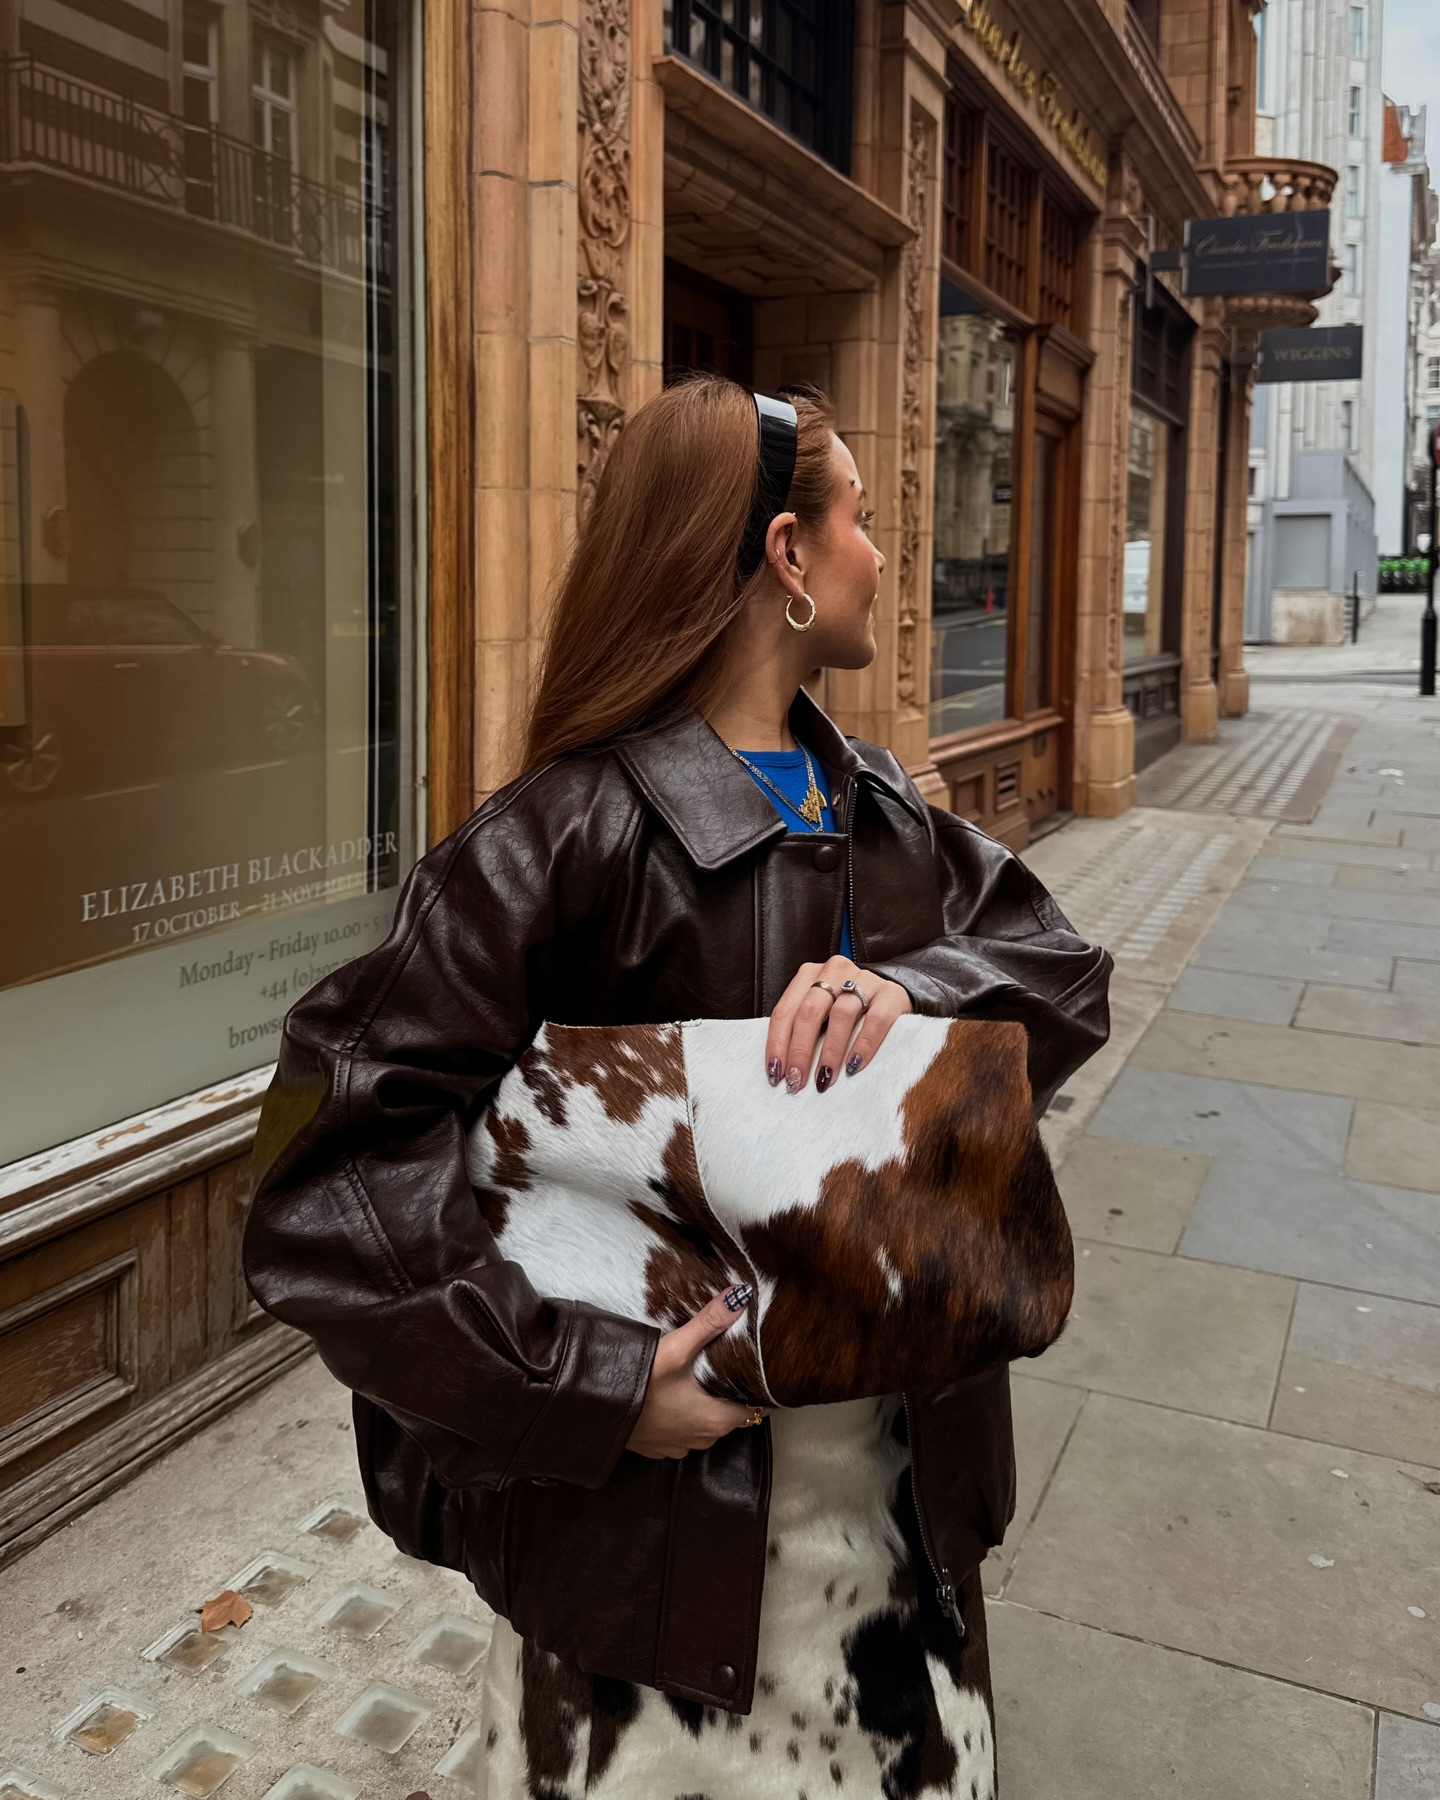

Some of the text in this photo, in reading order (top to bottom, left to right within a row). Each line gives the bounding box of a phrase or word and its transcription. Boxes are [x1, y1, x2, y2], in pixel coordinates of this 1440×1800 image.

[1273, 345, 1353, 361] WIGGINS
[80, 831, 397, 922] ELIZABETH BLACKADDER
[132, 922, 150, 943] 17
[154, 901, 241, 937] OCTOBER
[178, 951, 254, 988] Monday
[269, 931, 320, 961] Friday
[260, 979, 288, 1001] +44
